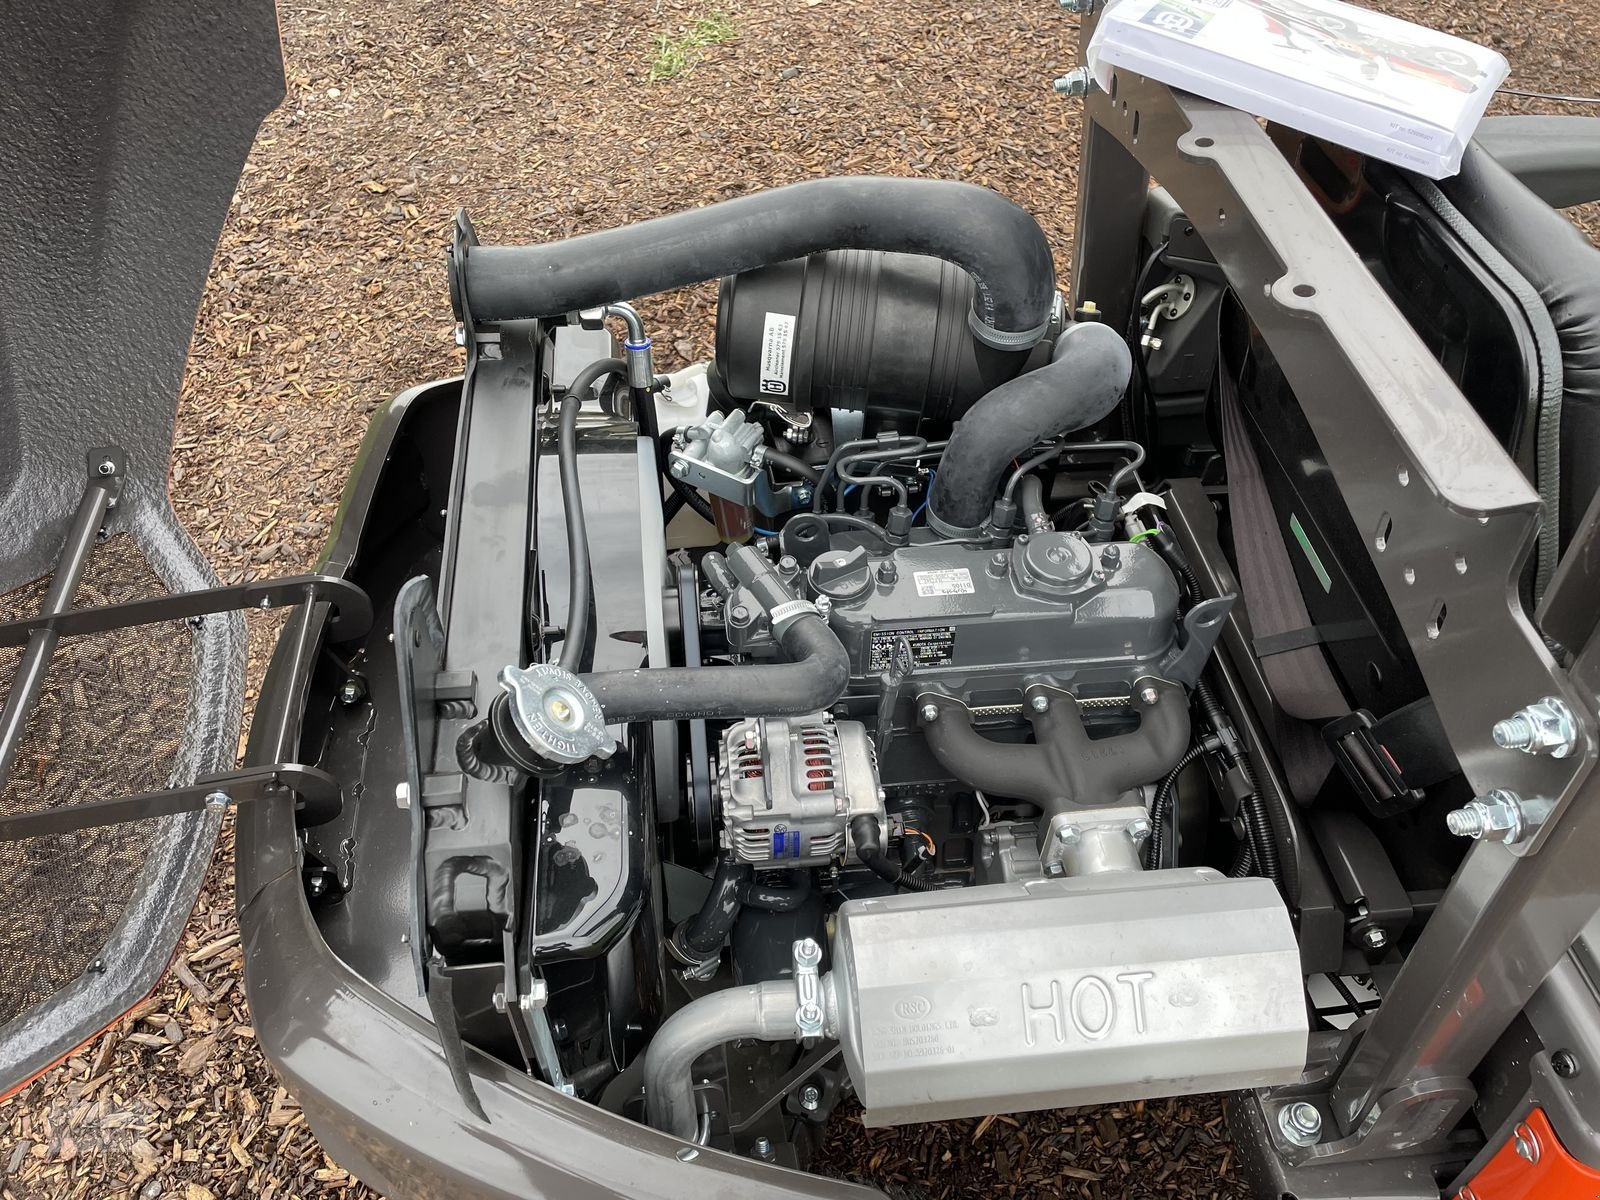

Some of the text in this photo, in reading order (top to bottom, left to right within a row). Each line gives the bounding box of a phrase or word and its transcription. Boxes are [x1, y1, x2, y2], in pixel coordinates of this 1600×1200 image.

[574, 679, 604, 721] REMOVE
[527, 711, 579, 754] TIGHTEN
[1021, 970, 1154, 1047] HOT
